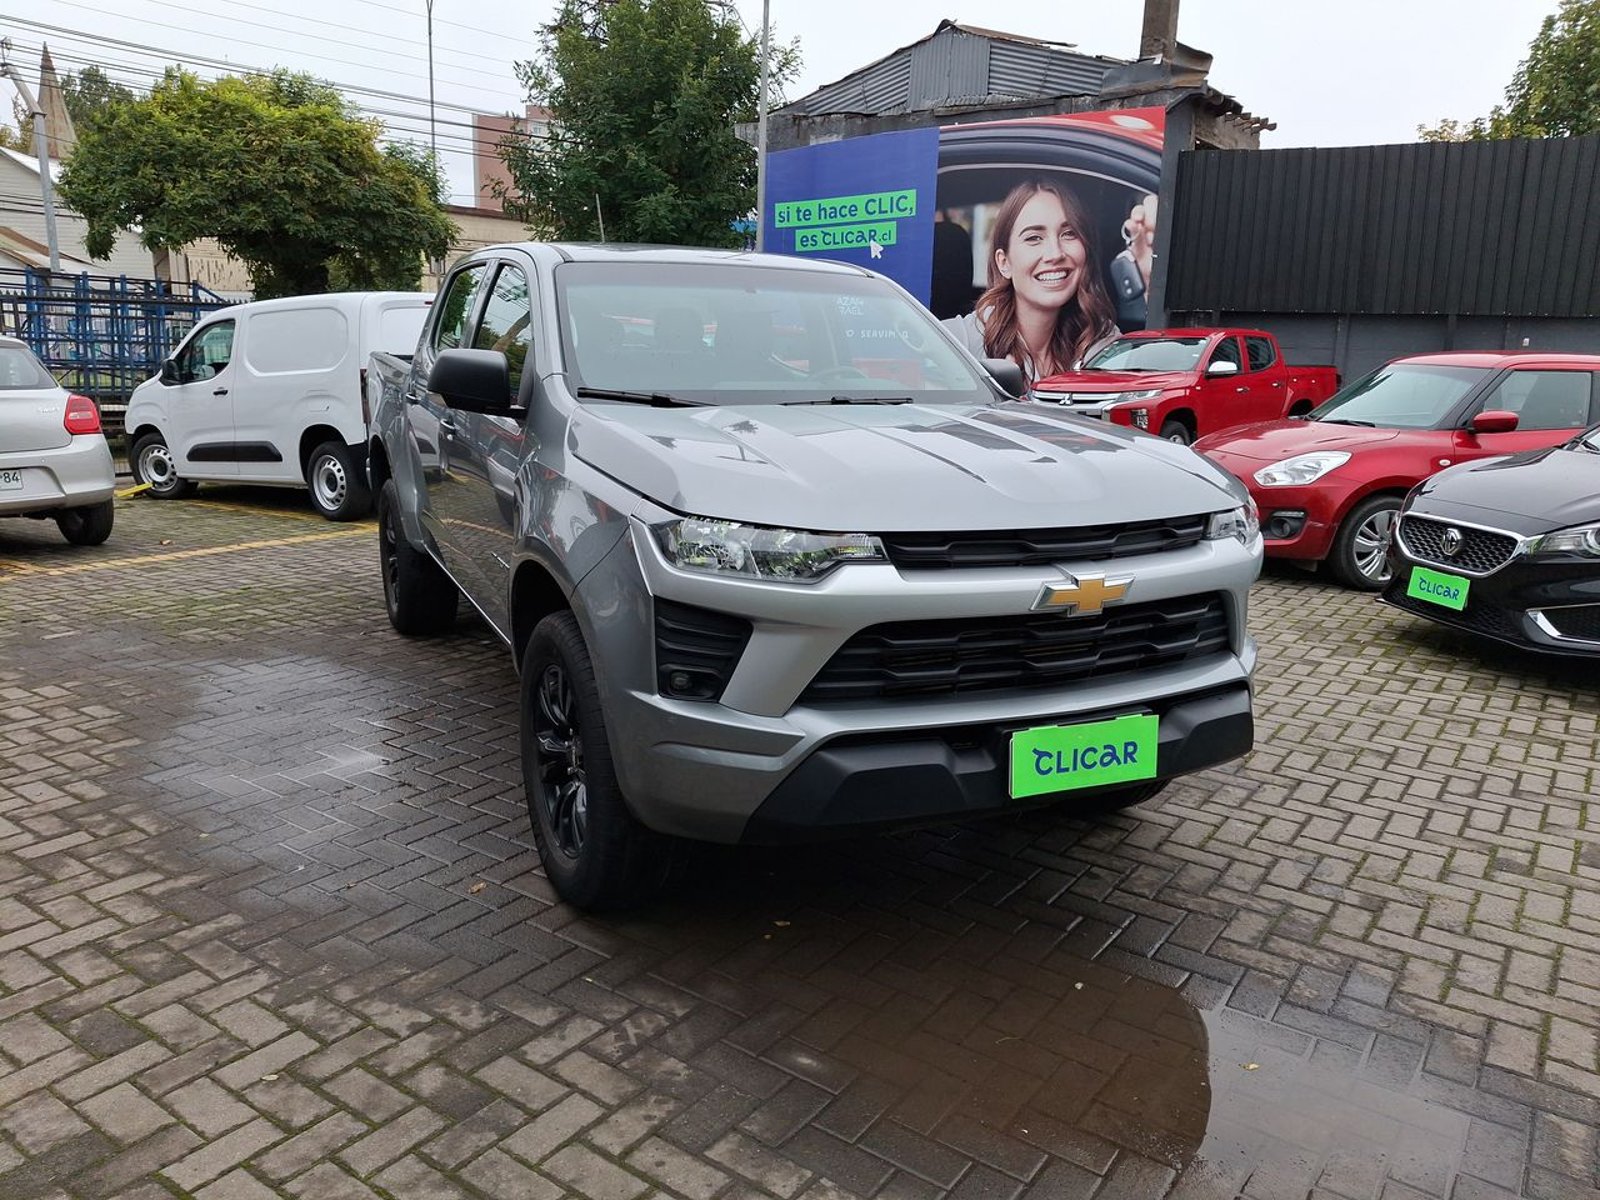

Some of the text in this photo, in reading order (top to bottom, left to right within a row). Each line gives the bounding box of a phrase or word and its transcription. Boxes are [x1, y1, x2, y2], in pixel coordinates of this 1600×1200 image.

[778, 195, 913, 223] si te hace CLIC,
[800, 234, 817, 247] es
